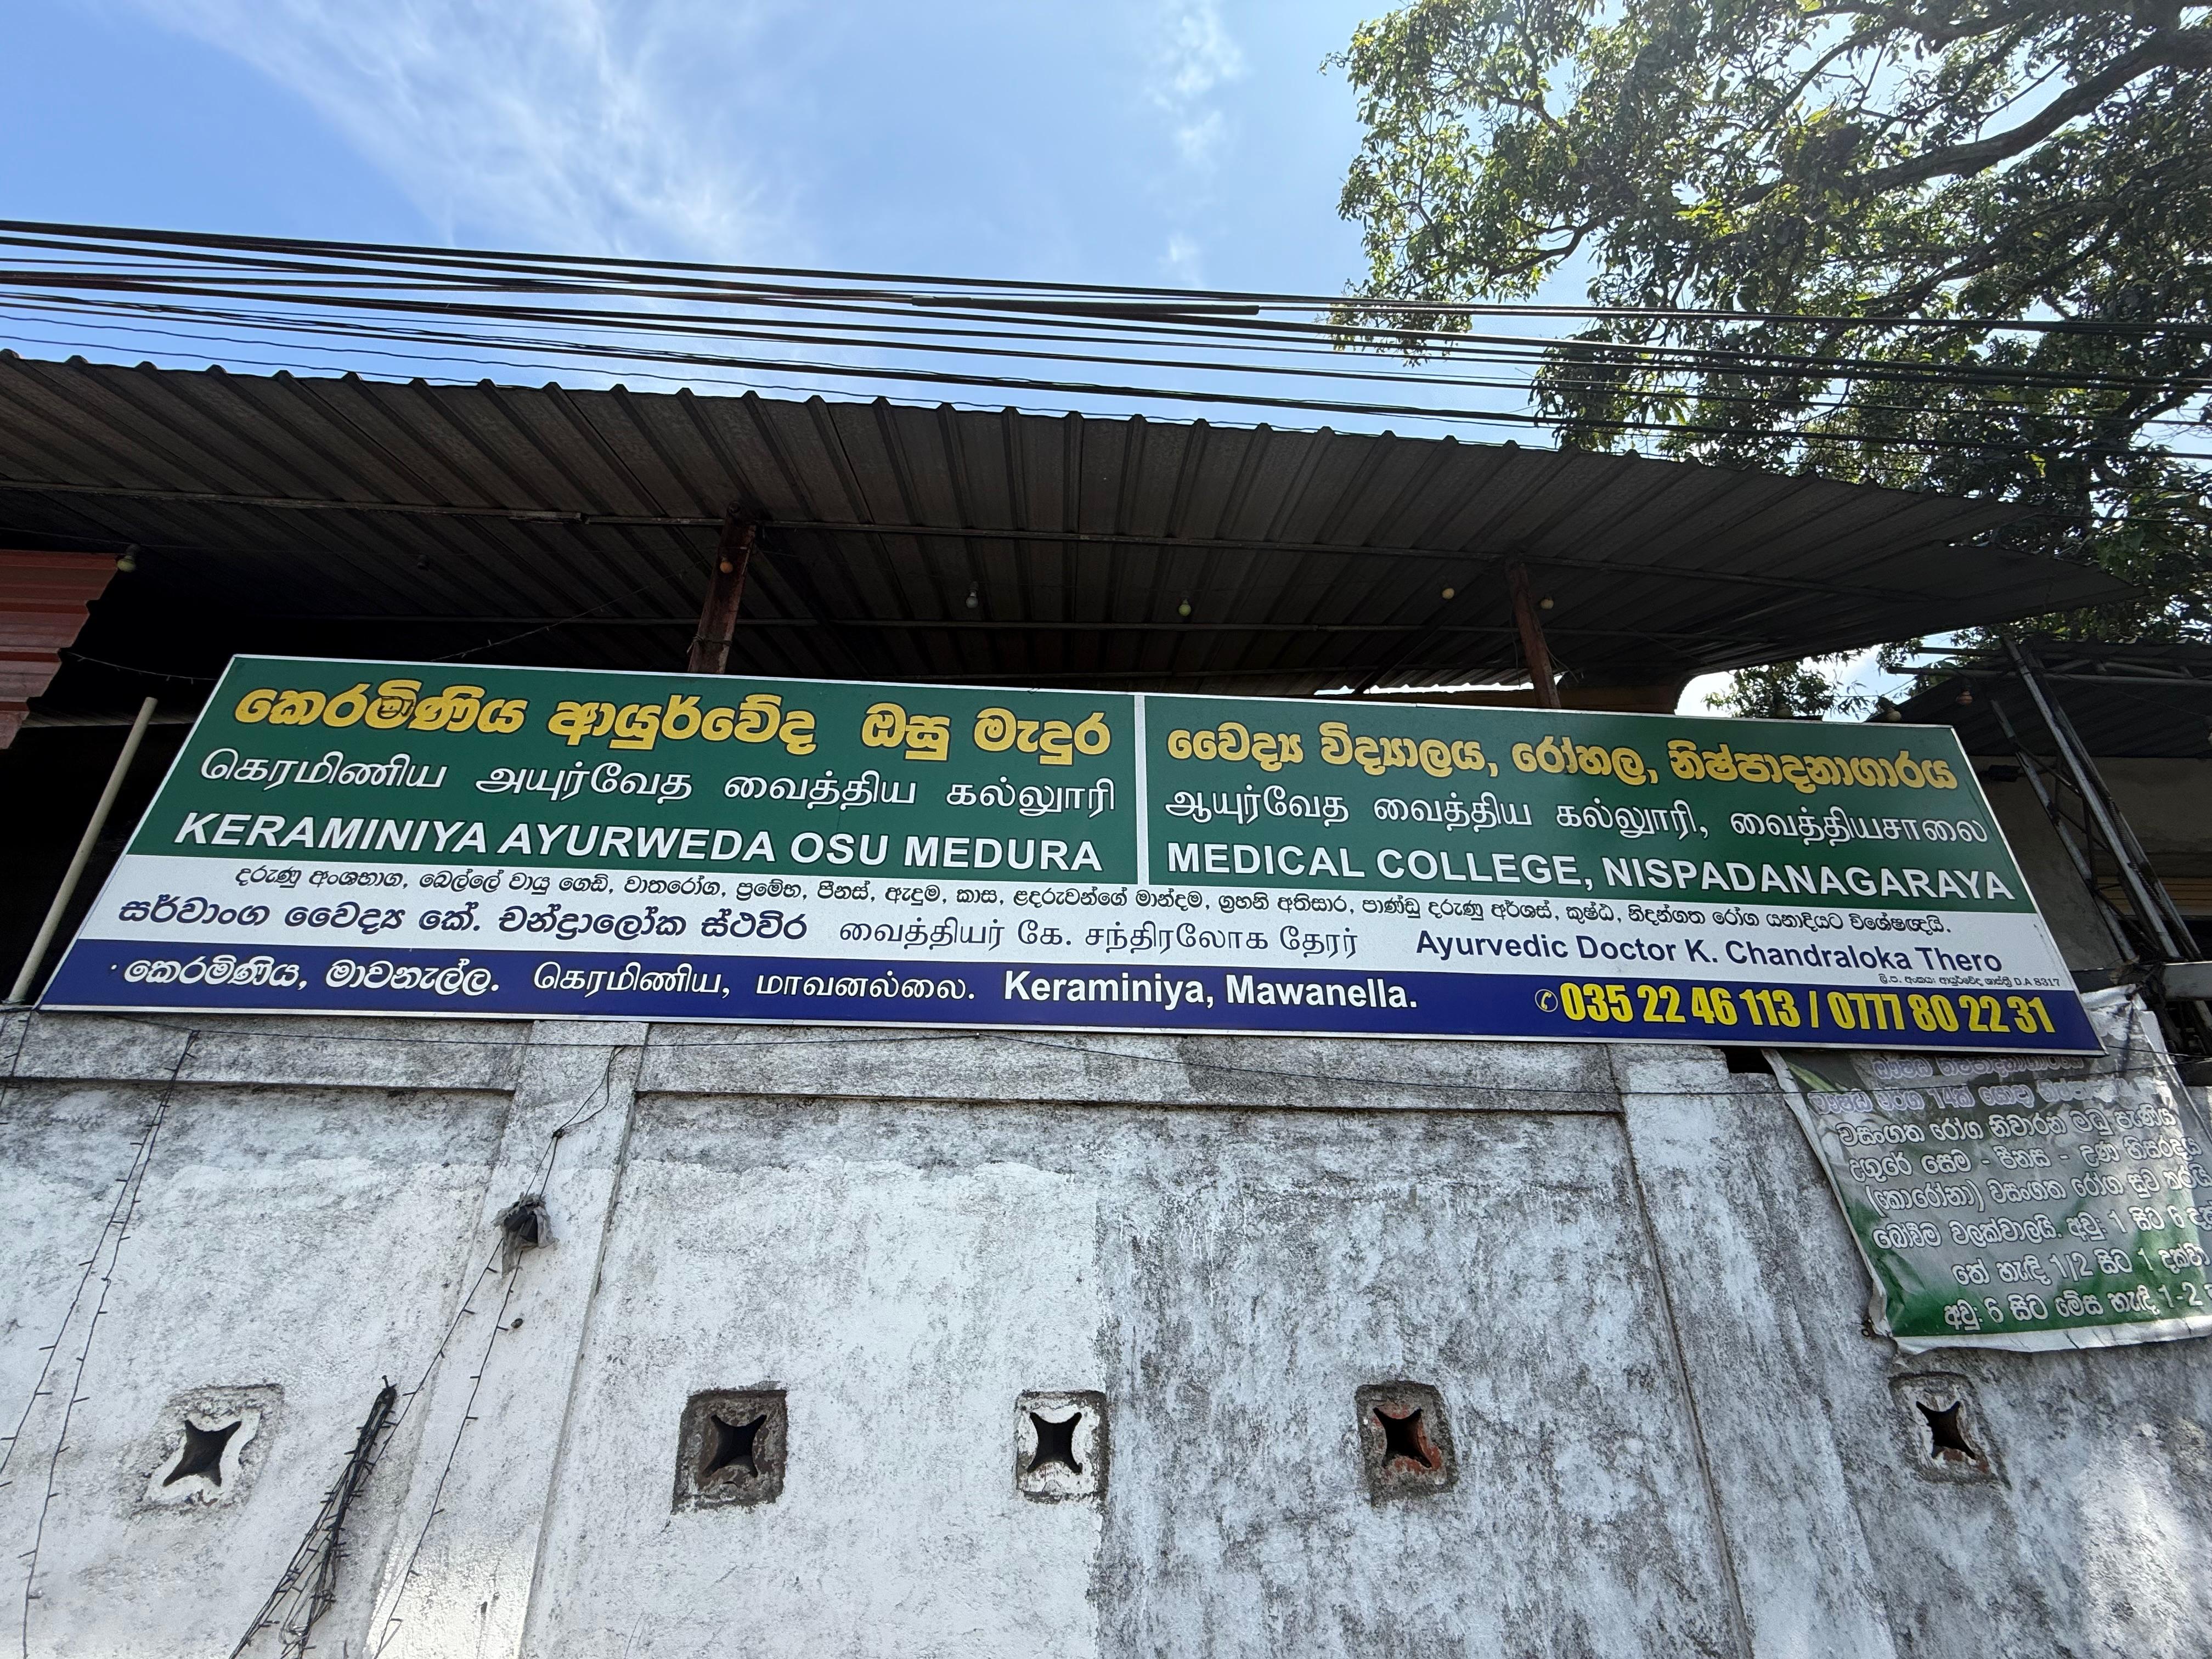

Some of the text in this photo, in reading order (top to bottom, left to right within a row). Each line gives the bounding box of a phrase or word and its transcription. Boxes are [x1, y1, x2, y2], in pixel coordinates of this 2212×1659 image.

[548, 693, 818, 755] ආයුර්වේද
[861, 703, 951, 761] ඔසු
[974, 707, 1113, 766] මැදුර
[1167, 720, 1959, 794] වෛද්‍ය විද්‍යාලය, රෝහල, නිෂ්පාදනාගාරය
[200, 748, 448, 791] கெரமிணிய
[476, 760, 693, 804] அயுர்வேத
[724, 769, 917, 810] வைத்திய
[1165, 784, 1350, 827] ஆயுர்வேத
[1374, 791, 1532, 833] வைத்திய
[1730, 805, 1988, 847] வைத்தியசாலை
[174, 812, 1103, 872] KERAMINIYA AYURWEDA OSU MEDURA
[1167, 842, 2016, 901] MEDICAL COLLEGE, NISPADANAGARAYA
[118, 894, 270, 926] සර්වාංග
[284, 901, 407, 934] වෛද්‍ය
[418, 901, 481, 932] කේ.
[700, 908, 808, 940] ස්ථවිර
[235, 865, 302, 889] දරුණු
[508, 873, 551, 896] වායු
[558, 873, 613, 894] ගෙඩි,
[624, 876, 726, 898] වාතරෝග,
[885, 885, 947, 906] ඇදුම,
[956, 888, 1004, 906] කාස,
[1013, 887, 1128, 909] ළදරුවන්ගේ
[1135, 888, 1210, 911] මාන්දම,
[1277, 893, 1355, 914] අතිසාර,
[1362, 895, 1421, 919] පාණ්ඩු
[1428, 899, 1484, 921] දරුණු
[1628, 904, 1706, 927] නිදන්ගත
[1713, 906, 1760, 927] රෝග
[839, 916, 1358, 959] வைத்தியர் கே. சந்திரலோக தேரர்
[1416, 929, 2002, 972] Ayurvedic Doctor K. Chandraloka Thero
[123, 954, 499, 997] කෙරමිණිය, මාවනැල්ල.
[533, 961, 975, 1000] கெரமிணிய, மாவனல்லை.
[1003, 970, 1418, 1011] Keraminiya, Mawanella.
[2034, 978, 2061, 987] 8317
[1560, 982, 1634, 1023] 035
[1637, 985, 1686, 1024] 22
[1691, 986, 1739, 1026] 46
[1739, 989, 1801, 1028] 113
[1827, 990, 1906, 1031] 0777
[1908, 994, 1960, 1034] 80
[1959, 996, 2011, 1034] 22
[2008, 996, 2056, 1034] 31
[1836, 1122, 1926, 1147] වසංගත
[1929, 1117, 1984, 1141] රෝග
[1921, 1148, 1972, 1175] සෙම
[1987, 1178, 2067, 1204] වසංගත
[2070, 1171, 2124, 1198] රෝග
[2108, 1210, 2128, 1233] 1
[2167, 1205, 2186, 1229] 6
[2049, 1251, 2095, 1282] 1/2
[2137, 1247, 2154, 1272] 1
[1983, 1296, 2004, 1324] 6
